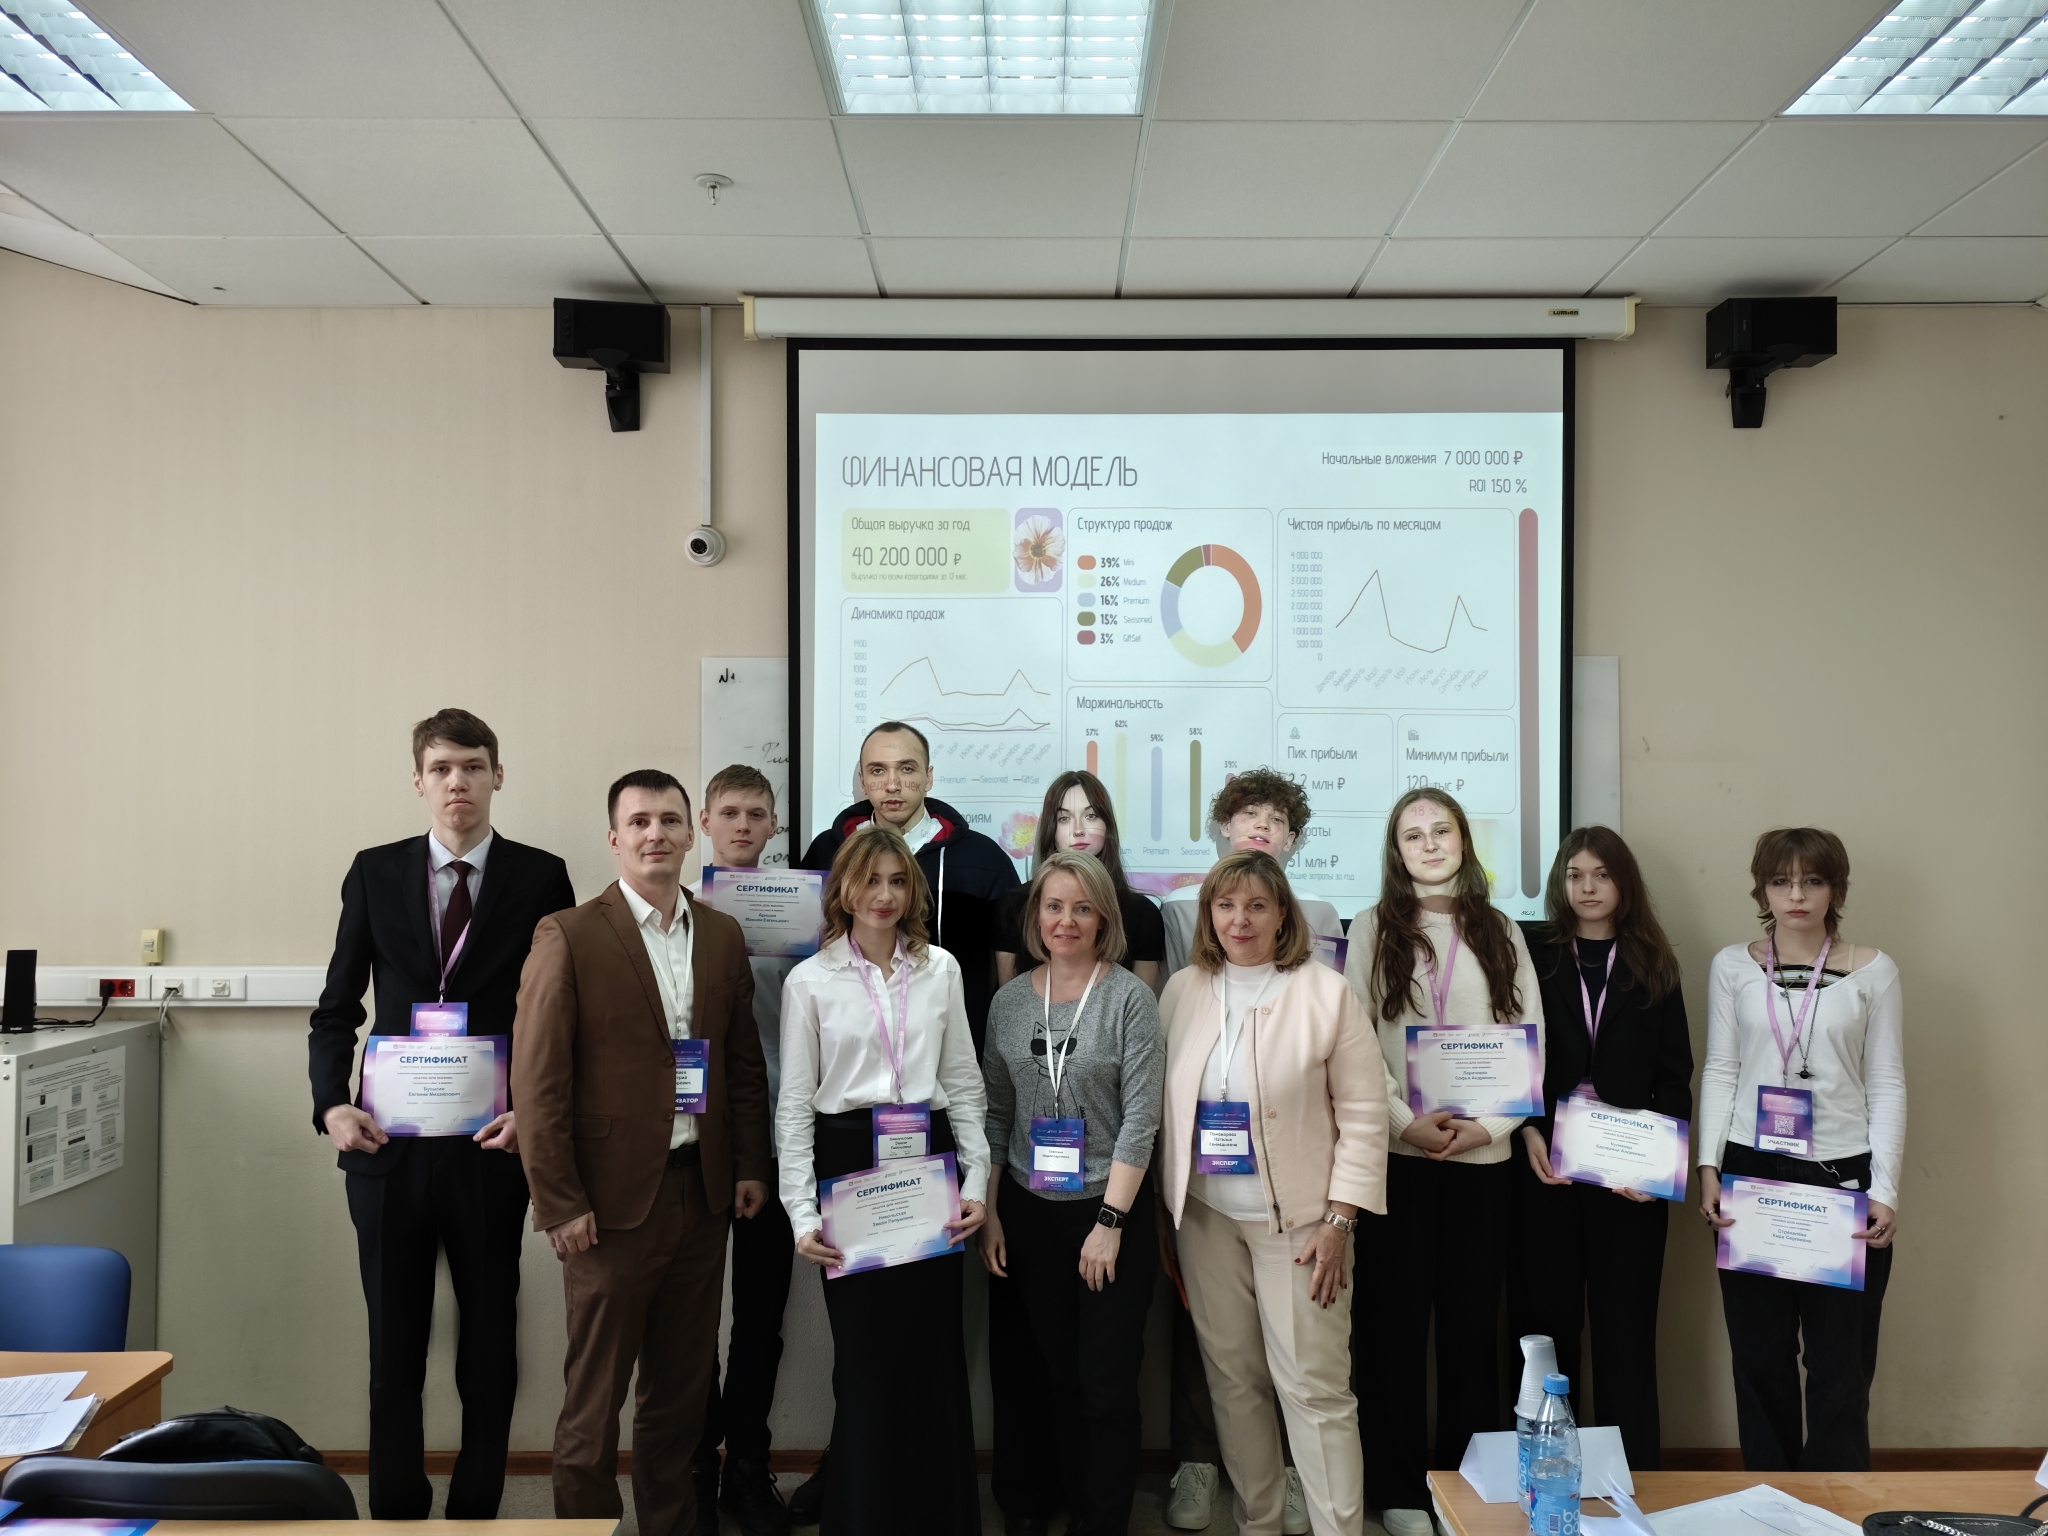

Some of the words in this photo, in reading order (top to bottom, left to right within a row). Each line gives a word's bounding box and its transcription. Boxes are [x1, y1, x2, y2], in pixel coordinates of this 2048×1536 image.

[1322, 452, 1382, 465] Начальные
[1385, 454, 1436, 465] вложения
[1444, 451, 1452, 465] 7
[1456, 450, 1480, 465] 000
[1484, 450, 1509, 465] 000
[842, 455, 1022, 488] ФИНАНСОВАЯ
[1032, 455, 1138, 491] МОДЕЛЬ
[1470, 479, 1486, 492] ROI
[1491, 478, 1511, 493] 150
[1516, 479, 1527, 493] %
[852, 517, 886, 531] Общая
[888, 520, 934, 533] выручка
[938, 521, 948, 530] за
[952, 521, 970, 531] год
[1077, 517, 1130, 533] Структура
[1134, 520, 1173, 532] продаж
[1288, 518, 1323, 531] Чистая
[1327, 518, 1373, 534] прибыль
[1376, 520, 1390, 530] по
[1394, 520, 1441, 532] месяцам
[852, 546, 873, 566] 40
[879, 546, 910, 566] 200
[916, 546, 948, 566] 000
[1100, 558, 1120, 568] 39%
[1100, 576, 1120, 587] 26%
[1100, 595, 1118, 606] 16%
[1123, 597, 1150, 605] Premium
[851, 607, 903, 620] Динамика
[906, 608, 945, 622] продаж
[1100, 614, 1118, 625] 15%
[1100, 633, 1114, 644] 3%
[1076, 696, 1164, 712] Маржинальность
[1086, 728, 1098, 736] 57%
[1288, 746, 1307, 759] Пик
[1311, 746, 1358, 762] прибыли
[1406, 748, 1458, 764] Минимум
[1461, 749, 1509, 764] прибыли
[940, 776, 966, 784] Premium
[1312, 780, 1334, 790] млн
[1305, 858, 1327, 868] млн
[736, 884, 799, 894] СЕРТИФИКАТ
[400, 1056, 468, 1064] СЕРТИФИКАТ
[1591, 1112, 1655, 1131] СЕРТИФИКАТ
[1768, 1139, 1800, 1148] УЧАСТНИК
[856, 1178, 922, 1198] СЕРТИФИКАТ
[1758, 1196, 1828, 1214] СЕРТИФИКАТ
